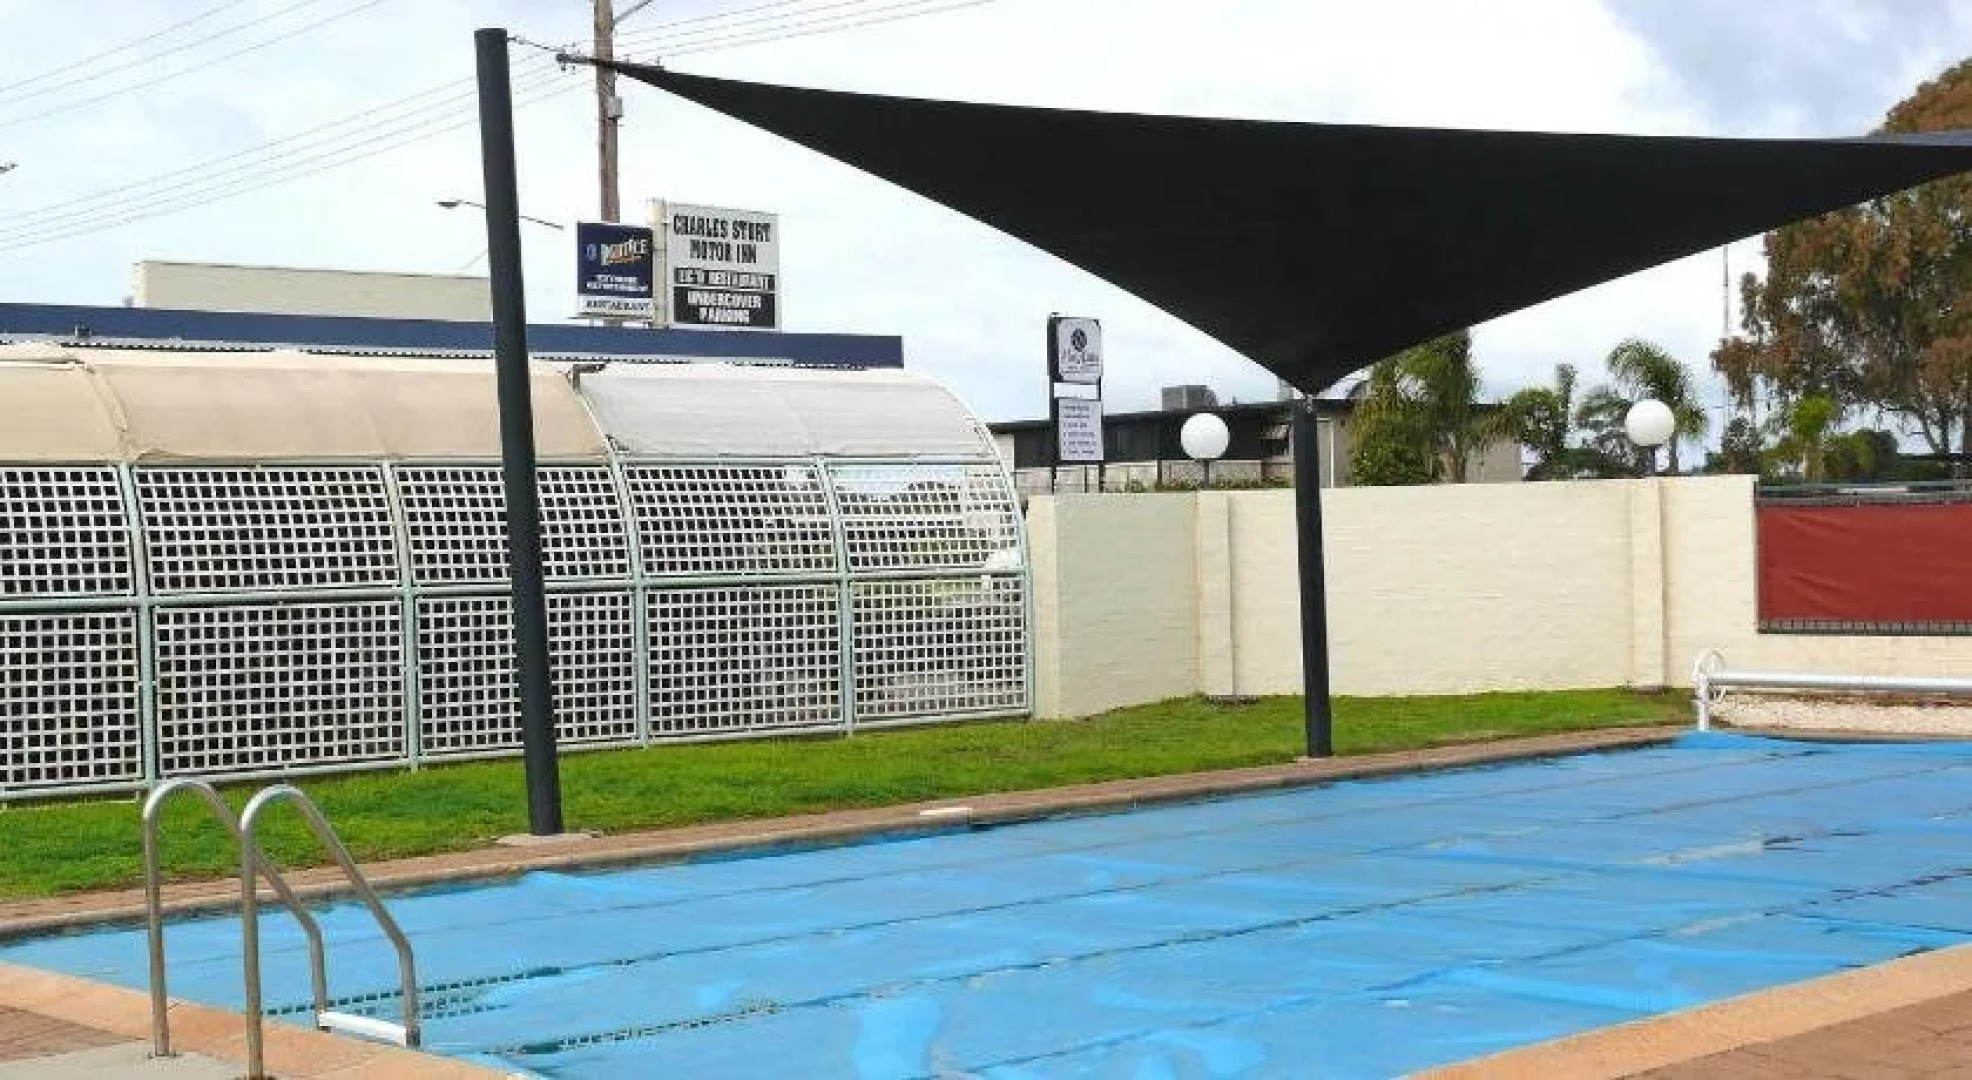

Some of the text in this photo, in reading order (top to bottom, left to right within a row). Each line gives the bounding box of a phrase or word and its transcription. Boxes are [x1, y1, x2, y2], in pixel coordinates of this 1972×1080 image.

[674, 214, 770, 242] CHARLES STURT
[690, 239, 756, 263] MOTOR INN
[687, 290, 761, 309] UNDERCOVER
